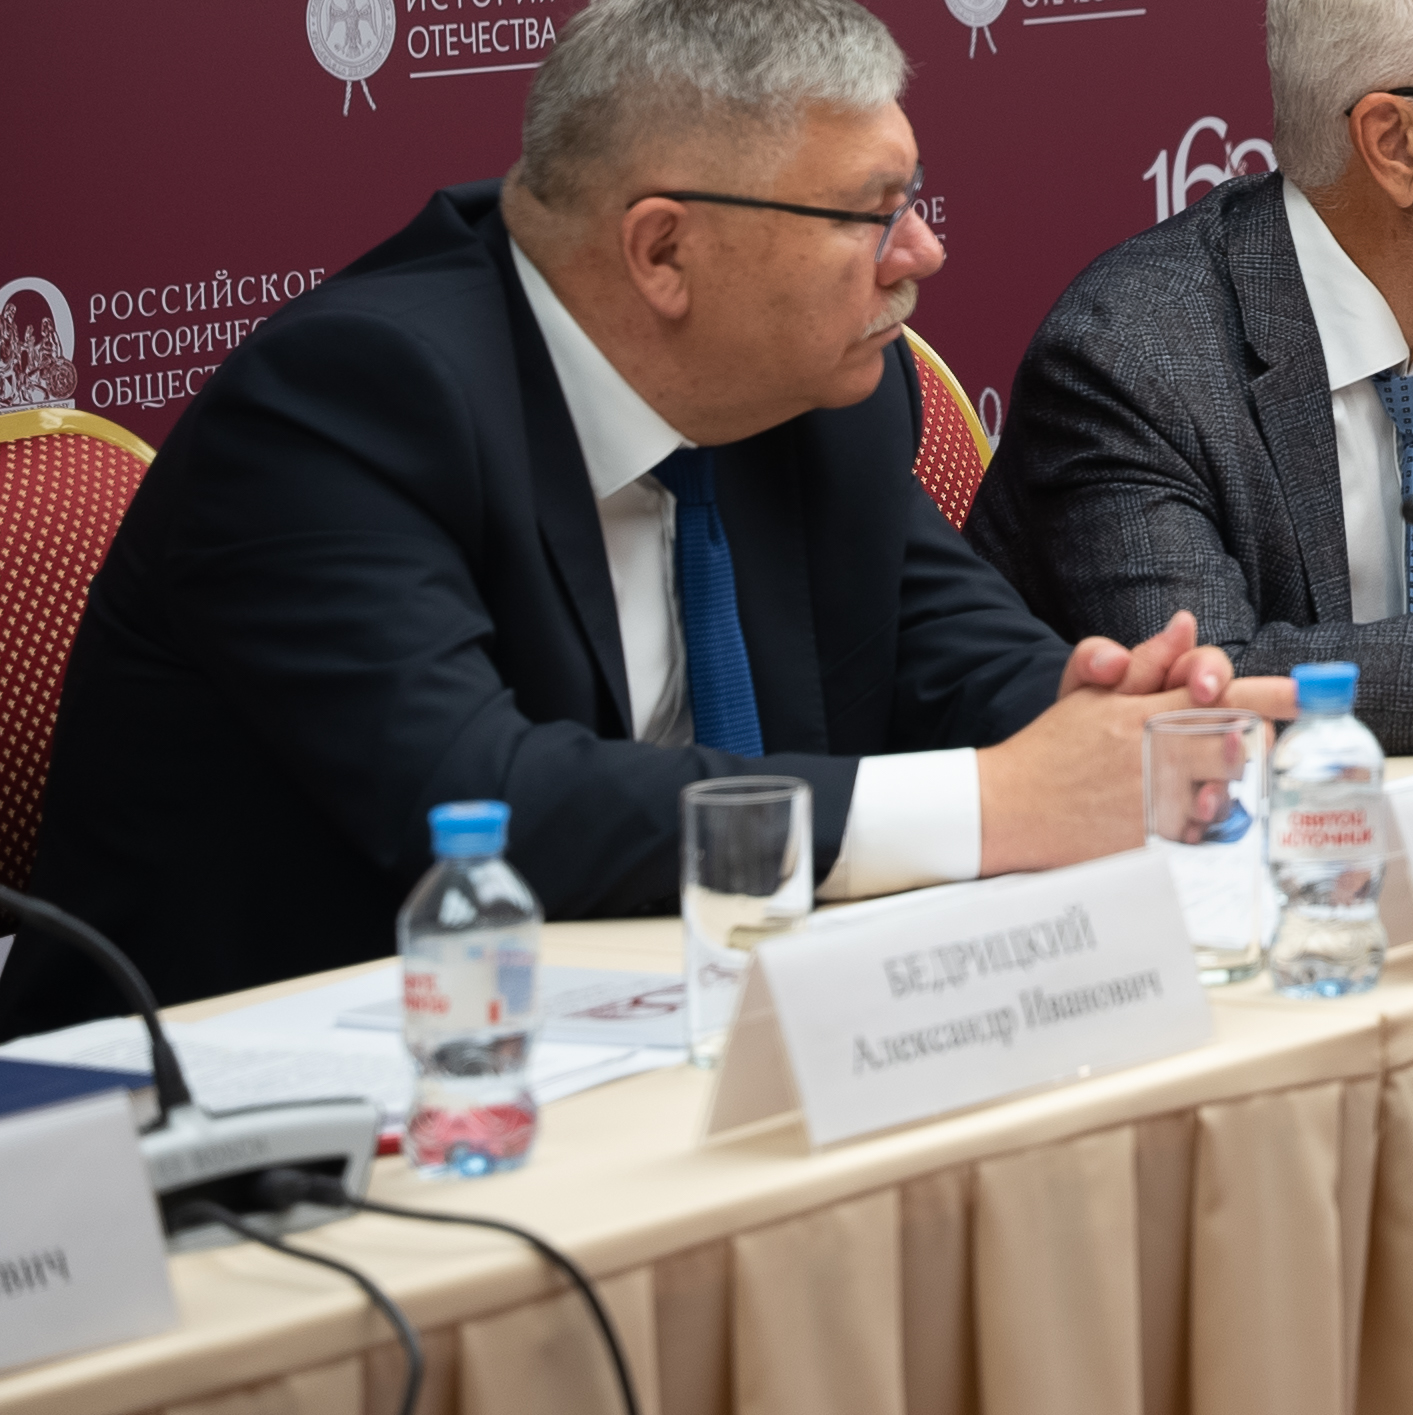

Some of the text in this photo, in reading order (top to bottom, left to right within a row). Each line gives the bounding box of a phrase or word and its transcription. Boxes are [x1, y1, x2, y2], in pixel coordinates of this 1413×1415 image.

[407, 16, 557, 59] ОТЕЧЕСТВА
[882, 905, 1098, 999] БЕДРИЦКИЙ
[852, 969, 1165, 1077] Александр Иванович
